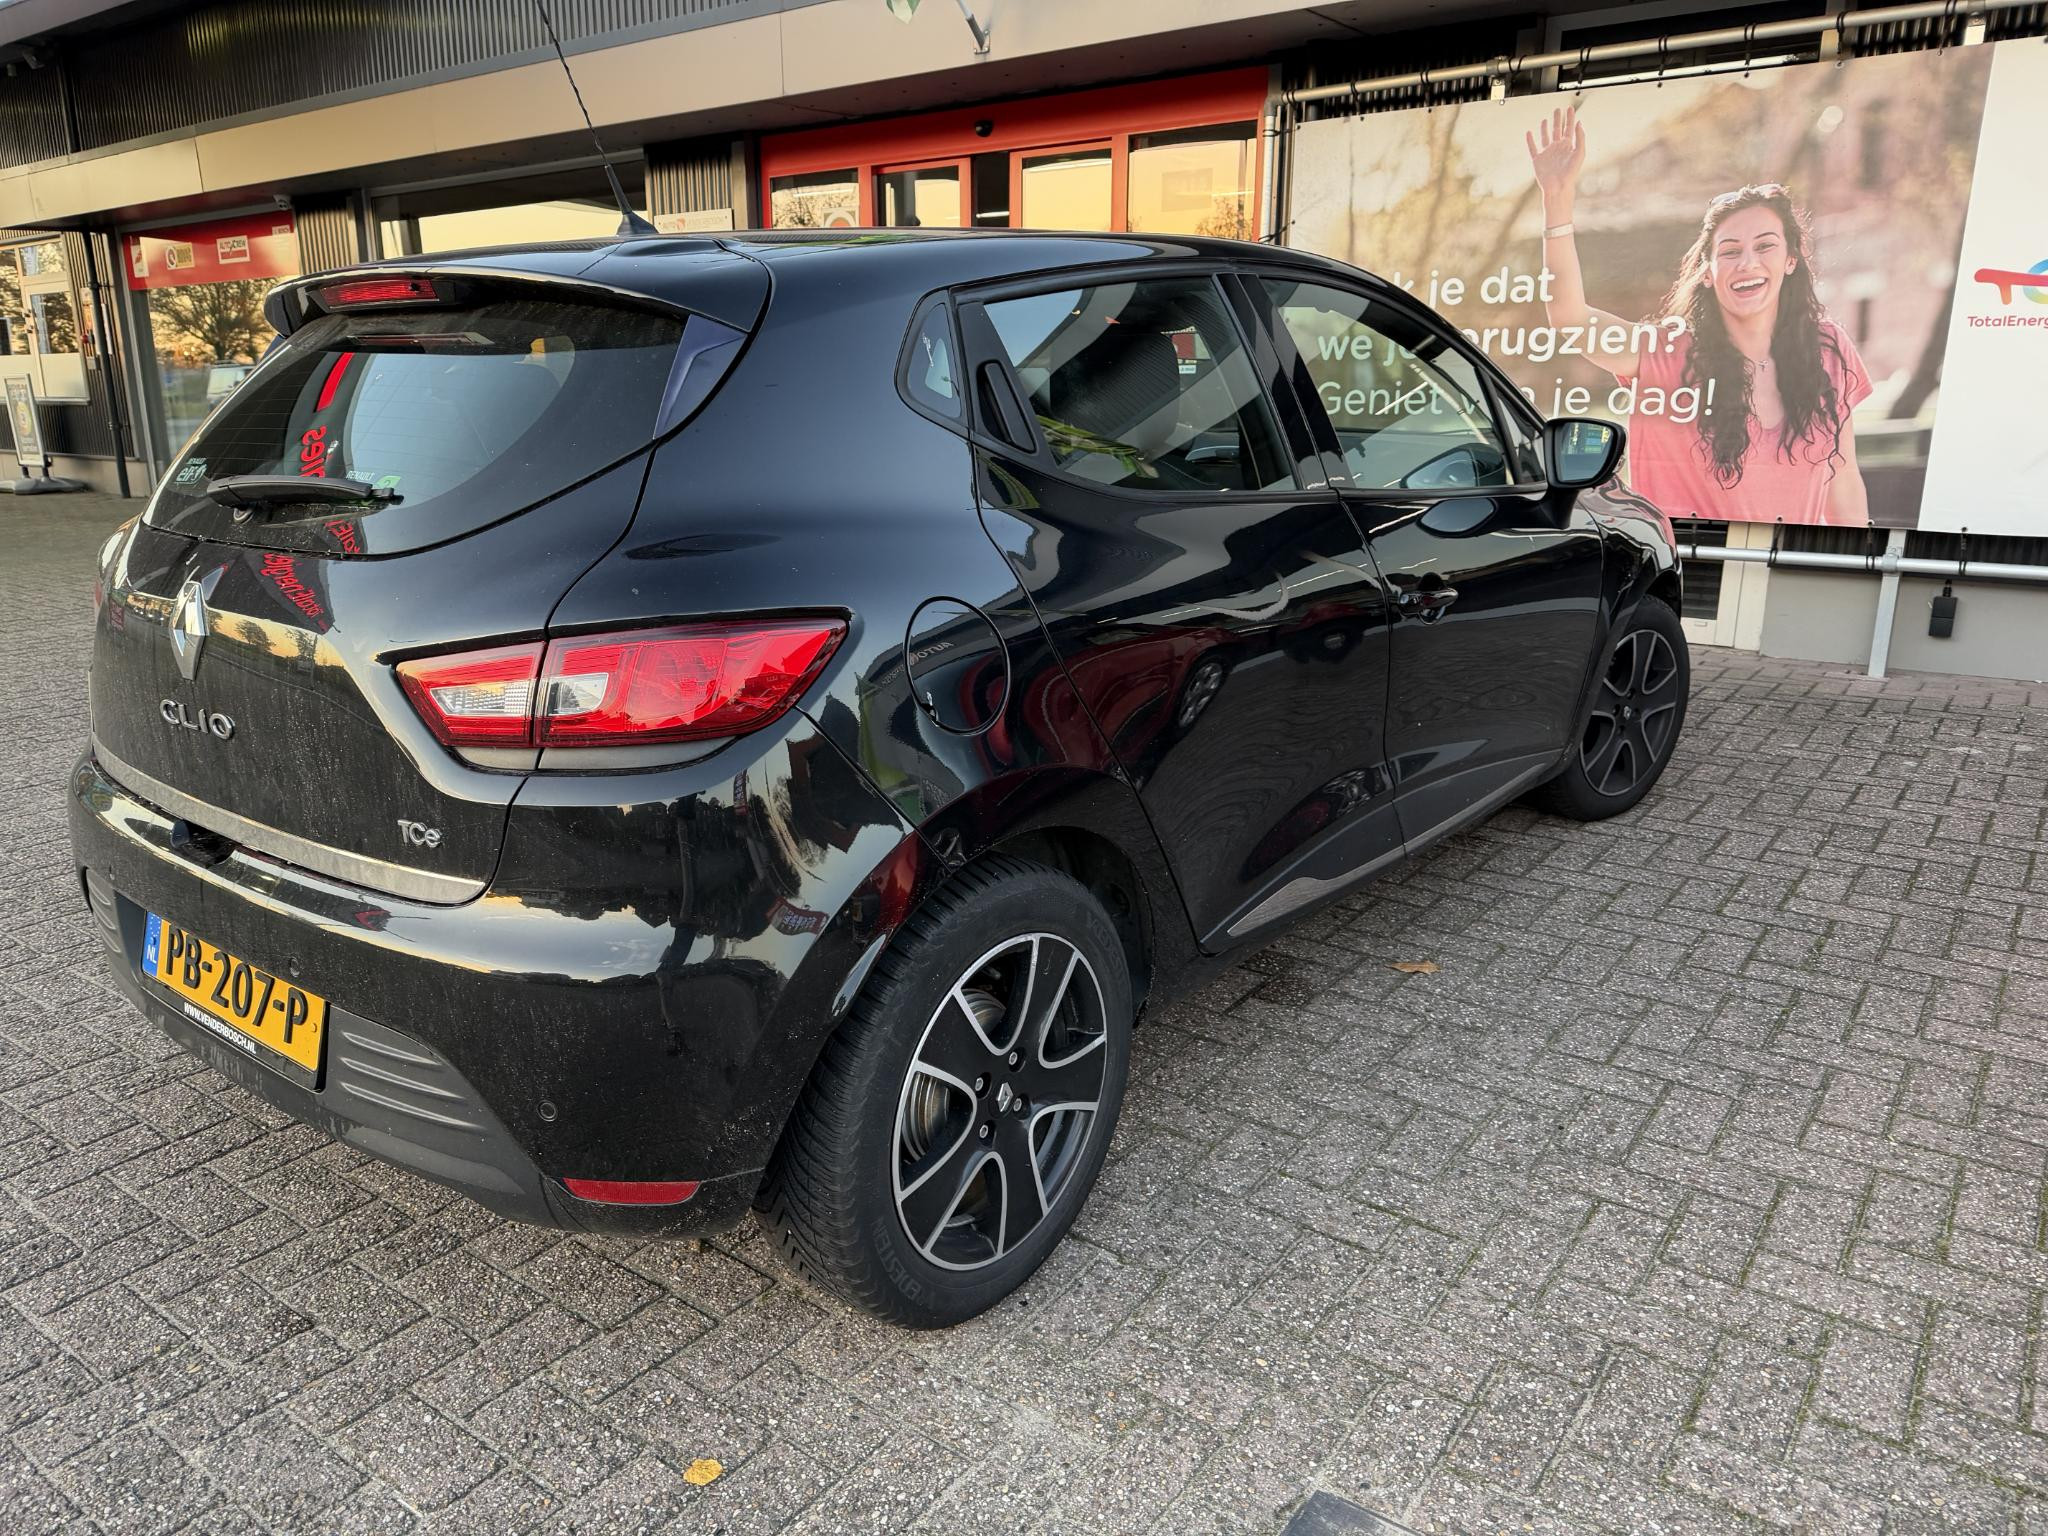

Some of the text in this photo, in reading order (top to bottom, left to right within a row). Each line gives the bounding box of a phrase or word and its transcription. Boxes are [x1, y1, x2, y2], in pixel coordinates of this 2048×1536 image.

[1429, 269, 1465, 308] je
[1480, 266, 1555, 304] dat
[1317, 333, 1373, 361] we
[1461, 315, 1687, 363] rugzien?
[1319, 380, 1443, 416] Geniet
[1552, 377, 1591, 416] je
[1607, 376, 1716, 424] dag!
[160, 699, 235, 741] CLIO
[397, 819, 443, 848] TCe
[146, 943, 158, 964] NL
[165, 922, 309, 1045] PB-207-P
